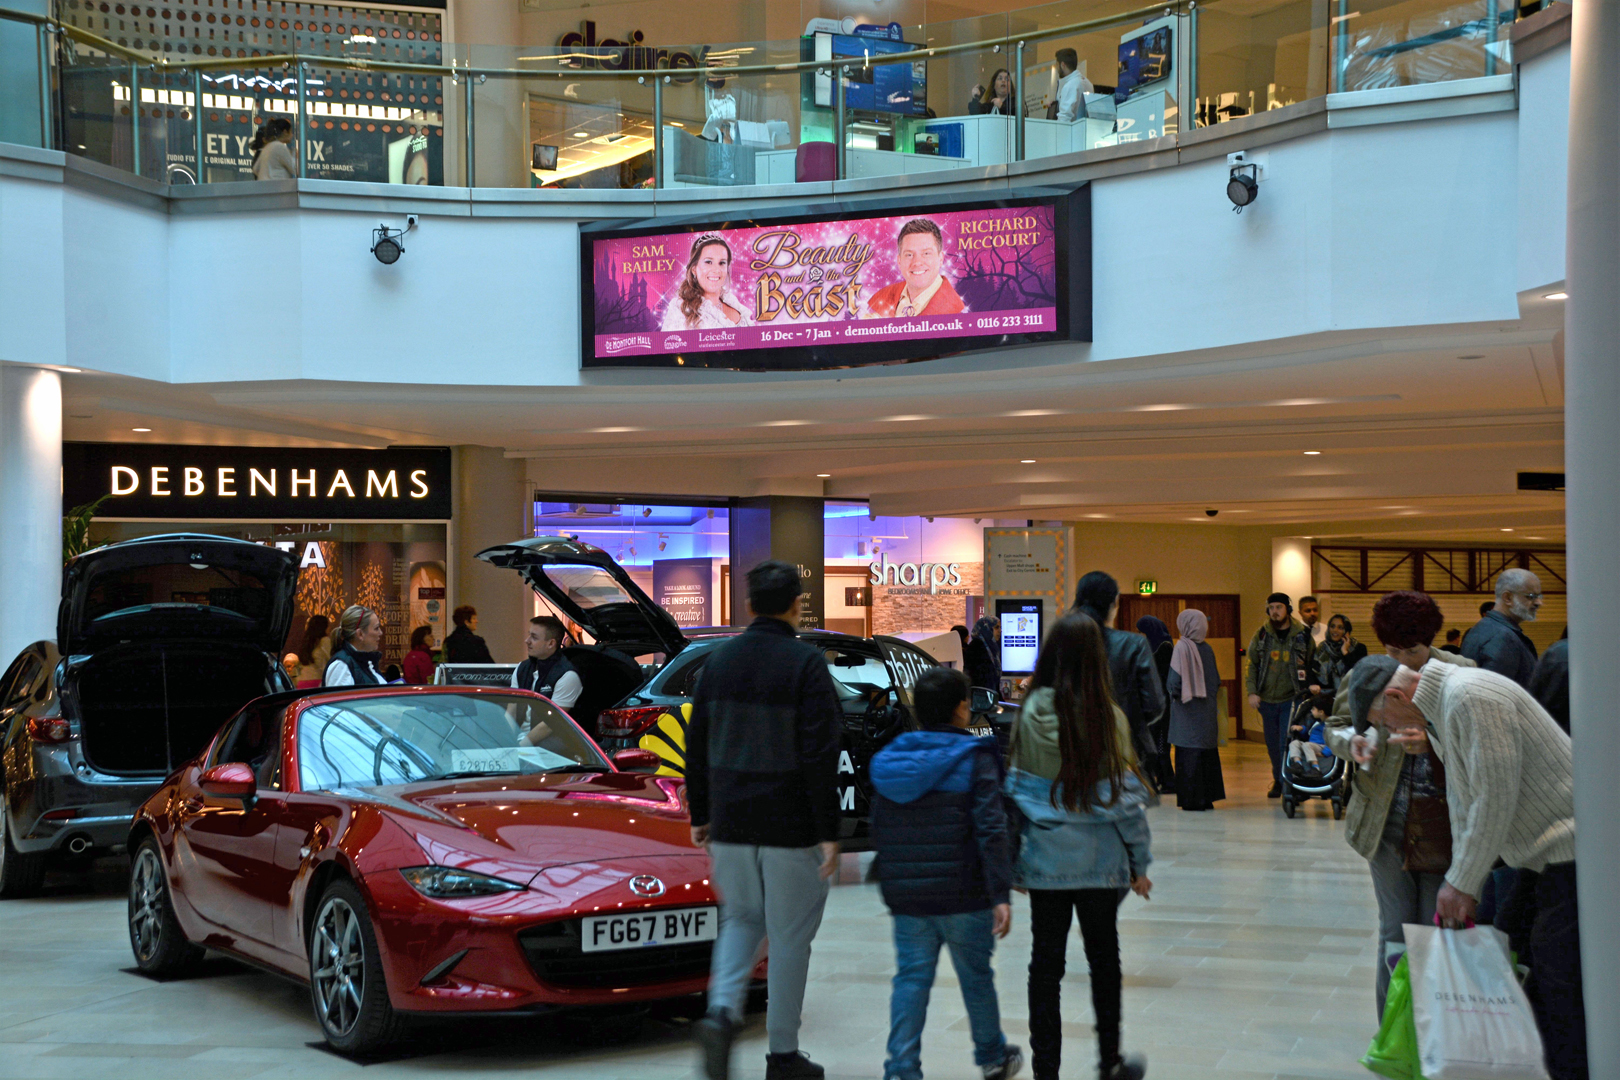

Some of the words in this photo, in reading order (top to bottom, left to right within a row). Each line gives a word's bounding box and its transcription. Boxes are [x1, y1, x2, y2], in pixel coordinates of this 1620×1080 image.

[210, 156, 237, 166] ORIGINAL
[960, 216, 1037, 234] RICHARD
[632, 244, 665, 258] SAM
[750, 230, 875, 276] Beauty
[622, 259, 676, 274] BAILEY
[784, 270, 806, 283] and
[825, 268, 840, 281] the
[756, 271, 863, 322] Beast
[760, 331, 771, 341] 16
[773, 330, 794, 341] Dec
[805, 329, 812, 339] 7
[812, 328, 832, 341] Jan
[844, 319, 963, 336] demontforthall.co.uk
[976, 317, 1000, 329] 0116
[1002, 316, 1021, 327] 233
[1023, 314, 1043, 326] 3111
[637, 335, 651, 346] HALL
[698, 331, 736, 342] Leicester
[111, 466, 430, 498] DEBENHAMS
[797, 564, 812, 578] llo
[869, 552, 962, 595] sharps
[661, 597, 671, 605] BE
[671, 596, 705, 605] INSPIRED
[593, 916, 657, 946] FG67
[664, 911, 708, 939] BYF
